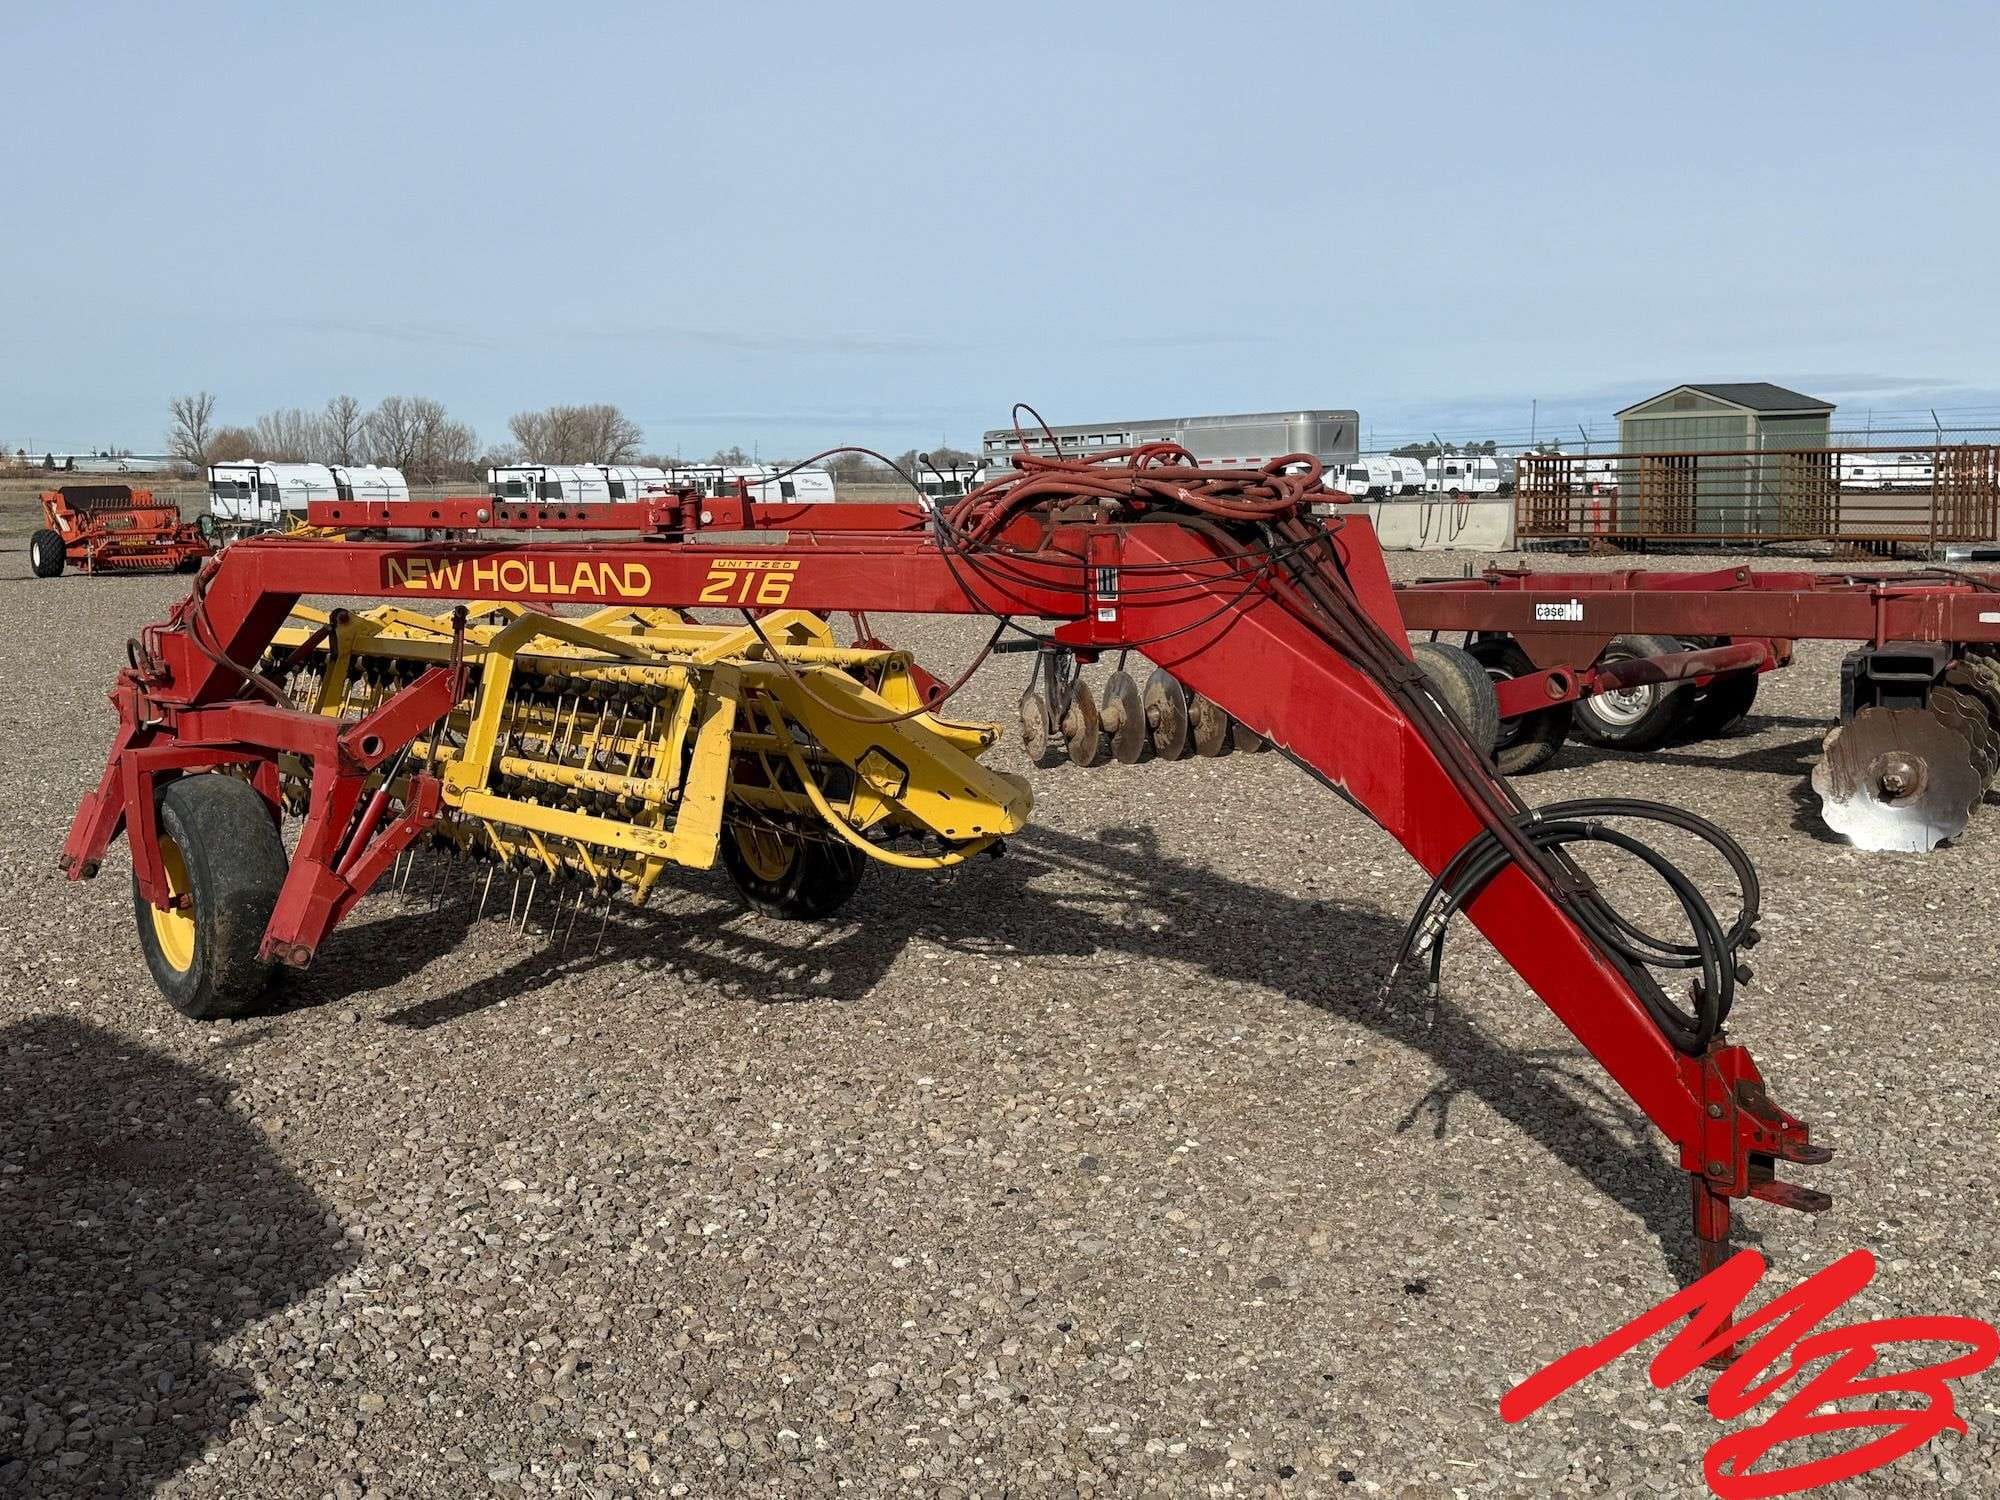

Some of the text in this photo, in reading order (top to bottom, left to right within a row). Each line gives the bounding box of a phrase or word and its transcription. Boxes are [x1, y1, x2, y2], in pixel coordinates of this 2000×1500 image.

[717, 561, 792, 569] UNITIZED
[387, 557, 652, 597] NEW HOLLAND
[700, 571, 795, 605] 216
[1537, 607, 1564, 617] case
